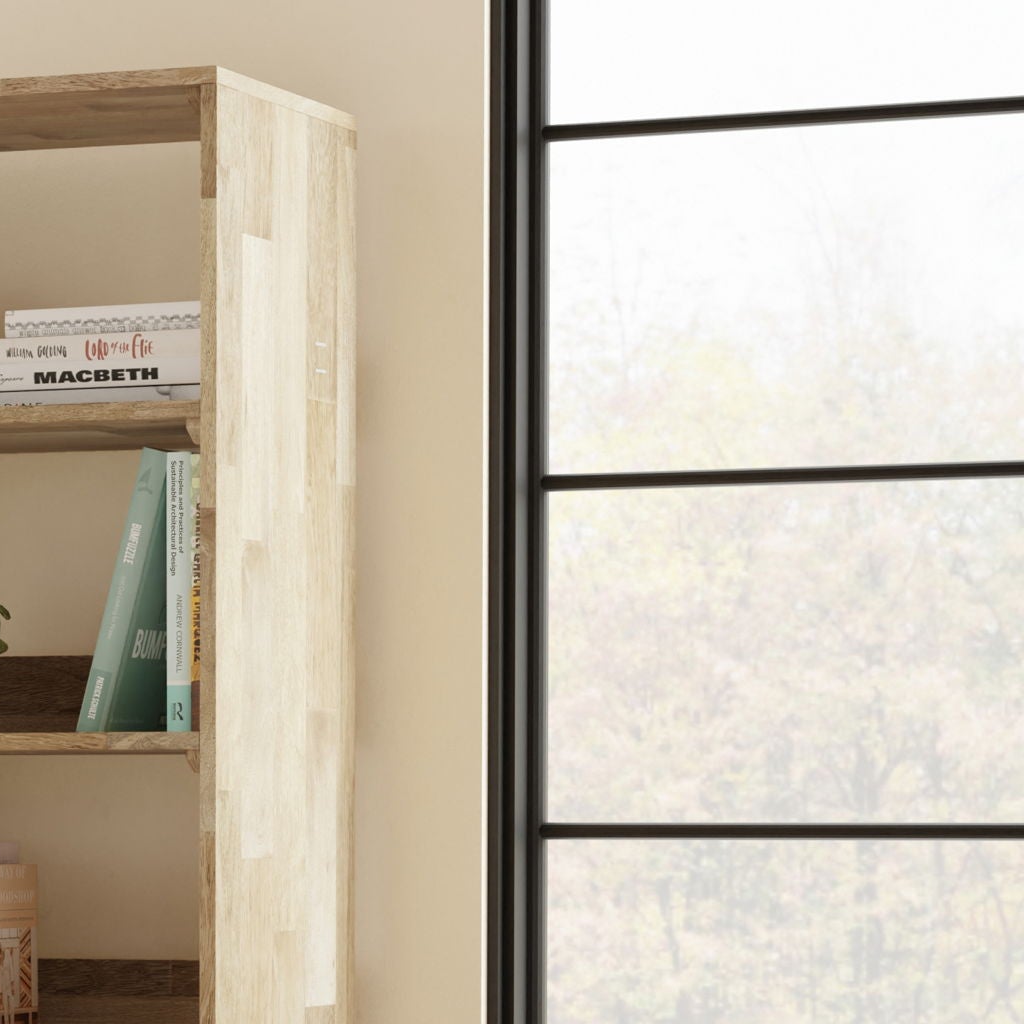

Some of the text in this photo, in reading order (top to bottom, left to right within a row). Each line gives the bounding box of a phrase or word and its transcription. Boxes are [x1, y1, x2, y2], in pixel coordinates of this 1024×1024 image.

[33, 367, 159, 385] MACBETH
[177, 460, 185, 495] Principles
[122, 522, 142, 565] BUMFUZZLE
[169, 551, 177, 577] Design
[175, 593, 183, 674] ANDREW CORNWALL
